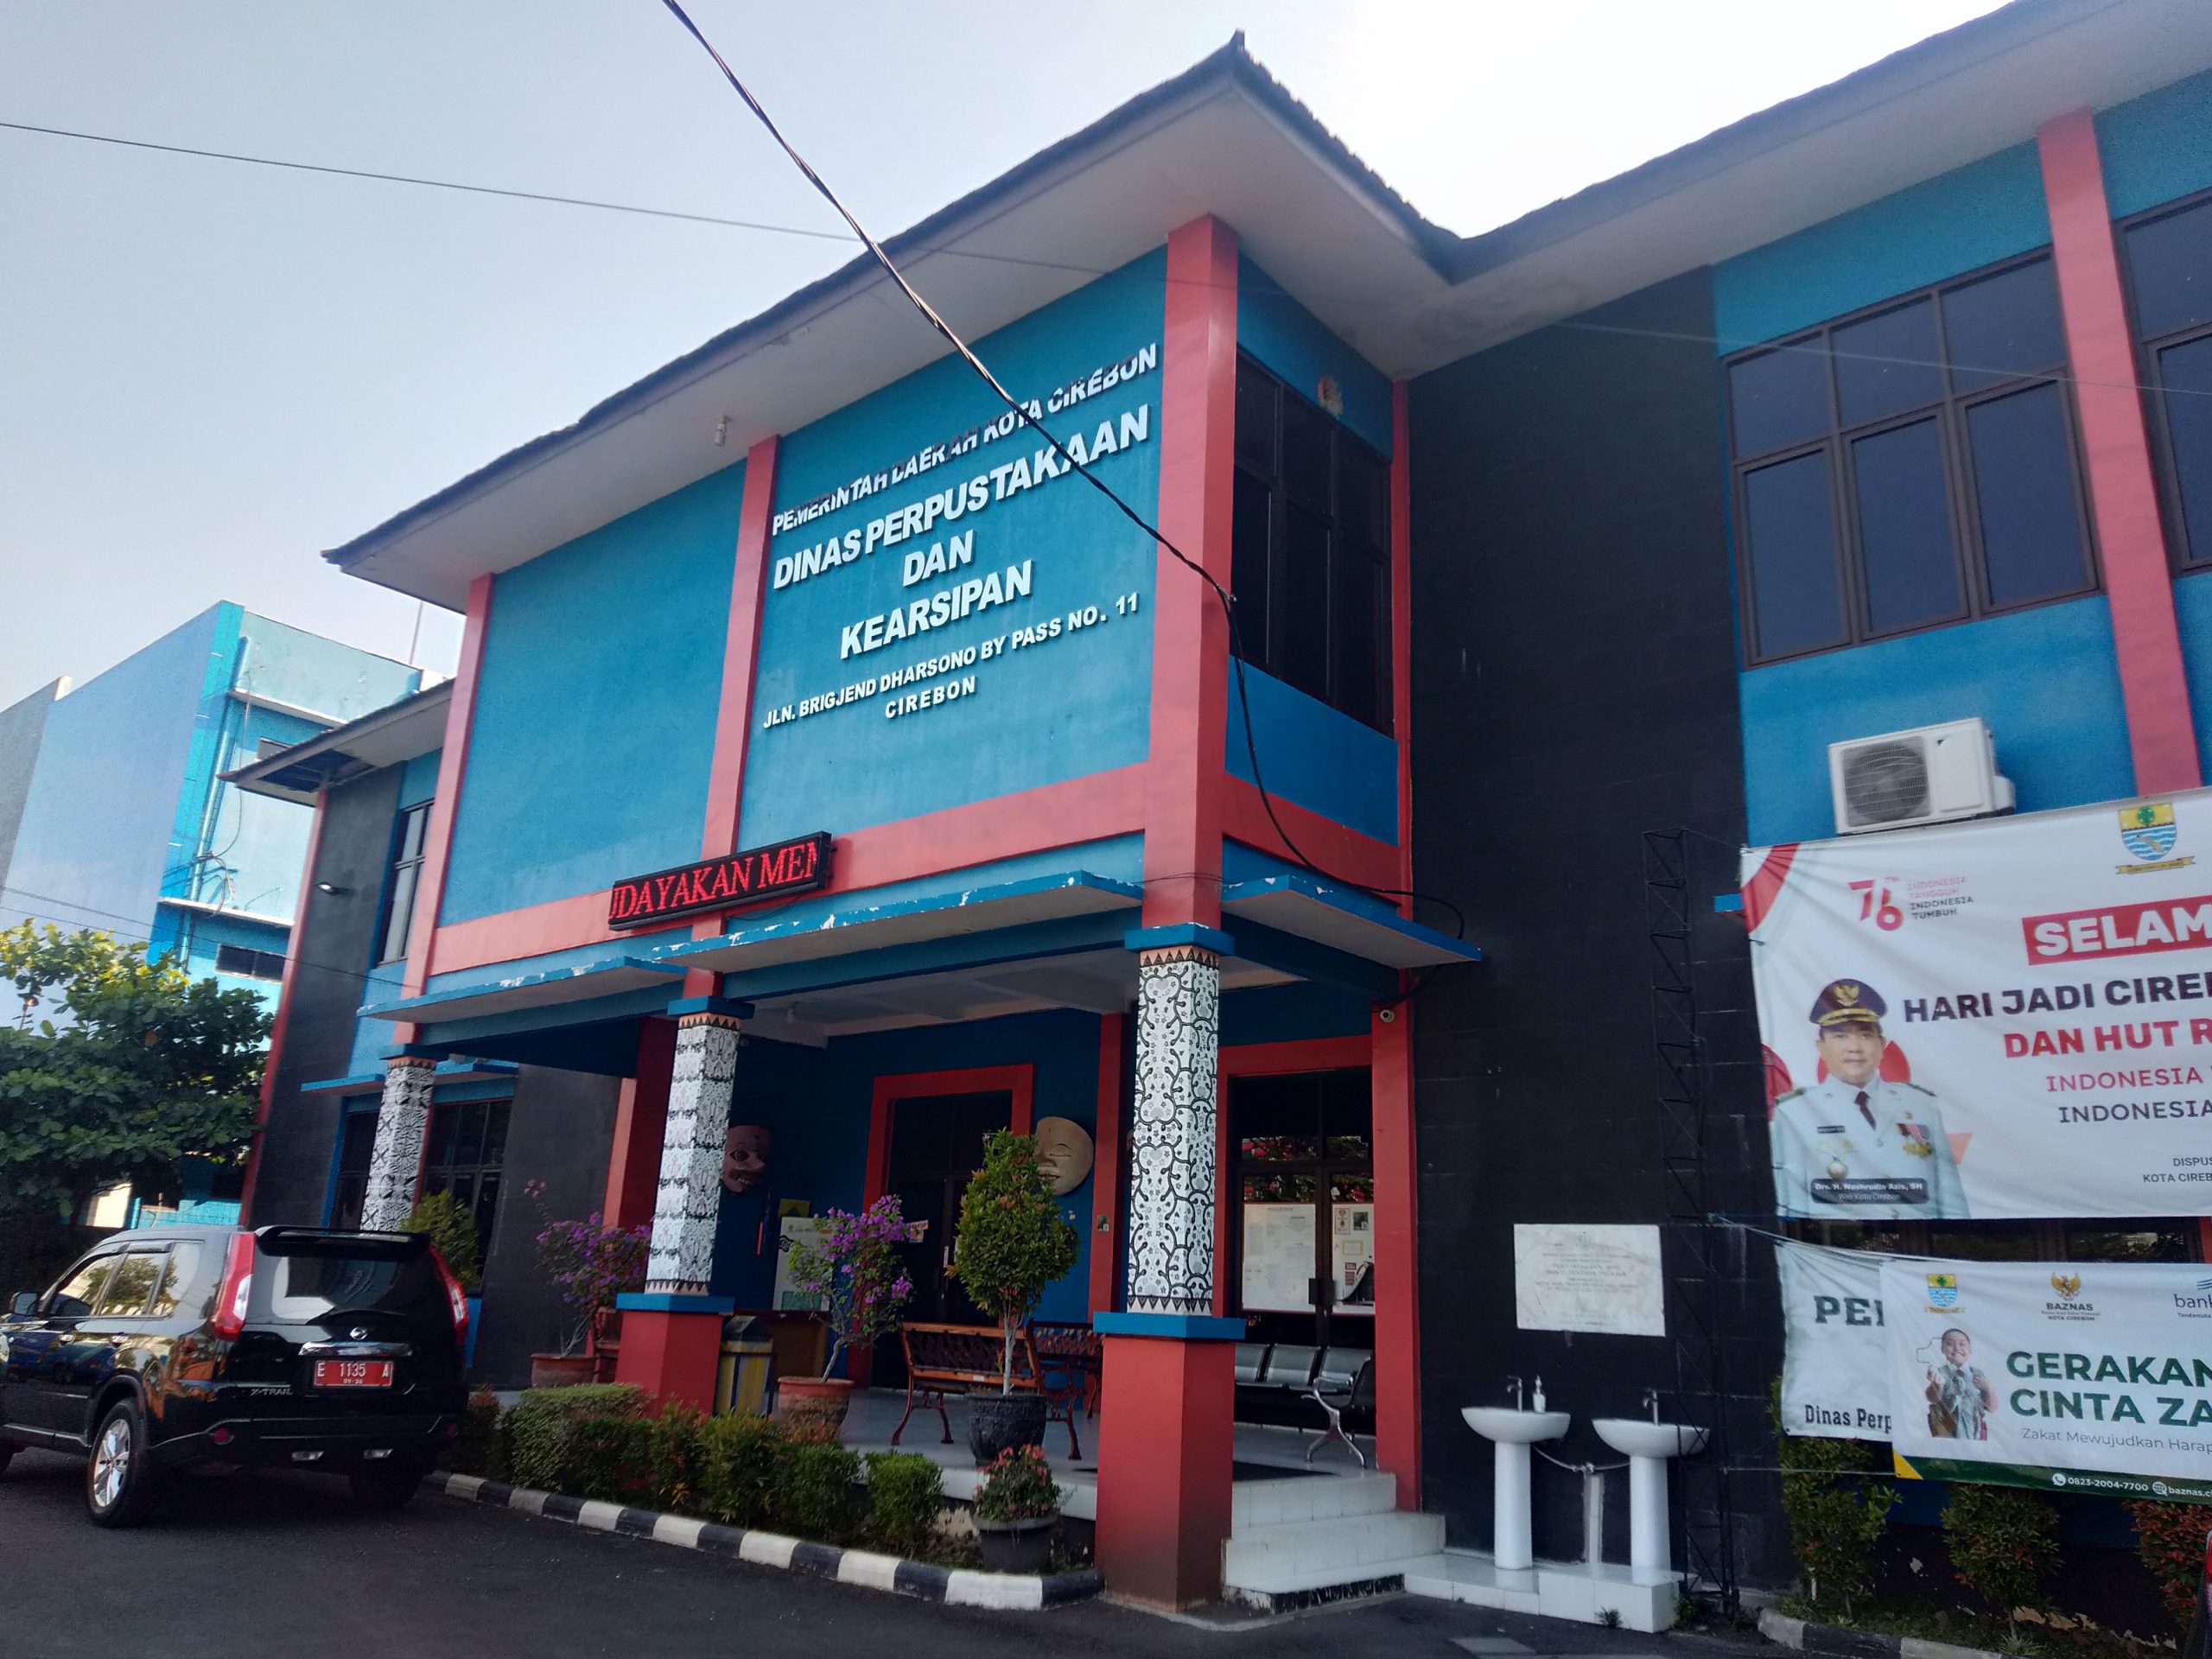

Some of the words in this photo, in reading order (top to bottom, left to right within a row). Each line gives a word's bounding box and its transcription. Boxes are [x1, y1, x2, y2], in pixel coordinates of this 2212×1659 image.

[772, 468, 888, 536] PEMERINTAH
[892, 426, 979, 485] DAERAH
[983, 398, 1043, 443] KOTA
[1047, 342, 1156, 414] CIREBON
[773, 529, 861, 589] DINAS
[865, 404, 1148, 554] PERPUSTAKAAN
[903, 530, 976, 587] DAN
[840, 560, 1033, 659] KEARSIPAN
[763, 704, 795, 728] JLN.
[799, 679, 876, 718] BRIGJEND
[880, 648, 976, 692] DHARSONO
[981, 637, 1006, 660] BY
[1011, 618, 1061, 650] PASS
[1068, 606, 1107, 632] NO.
[1116, 593, 1139, 615] 11
[885, 676, 976, 719] CIREBON
[1907, 876, 1967, 890] INDONESIA
[1847, 880, 1904, 931] 76
[1910, 896, 1974, 910] INDONESIA
[1911, 908, 1958, 919] TUMBUH
[2034, 904, 2212, 957] SELAM
[1904, 993, 1993, 1022] HARI
[2001, 983, 2094, 1014] JADI
[2004, 1028, 2084, 1058] DAN
[2094, 1020, 2179, 1052] HUT
[2190, 1018, 2212, 1045] R
[2046, 1066, 2203, 1092] INDONESIA
[2059, 1099, 2212, 1123] INDONESIA
[2143, 1173, 2176, 1183] KOTA
[2046, 1303, 2094, 1312] BAZNAS
[317, 1362, 325, 1376] E
[340, 1363, 365, 1377] 1135
[382, 1363, 389, 1377] A
[2006, 1351, 2212, 1388] GERAKAN
[250, 1388, 294, 1396] X-TRAIL
[1805, 1404, 1851, 1426] Dinas
[2010, 1389, 2145, 1424] CINTA
[2157, 1397, 2212, 1427] ZA
[2022, 1428, 2062, 1441] Zakat
[2066, 1431, 2164, 1447] Mewujudkan
[2068, 1477, 2149, 1491] 0823-2004-7700
